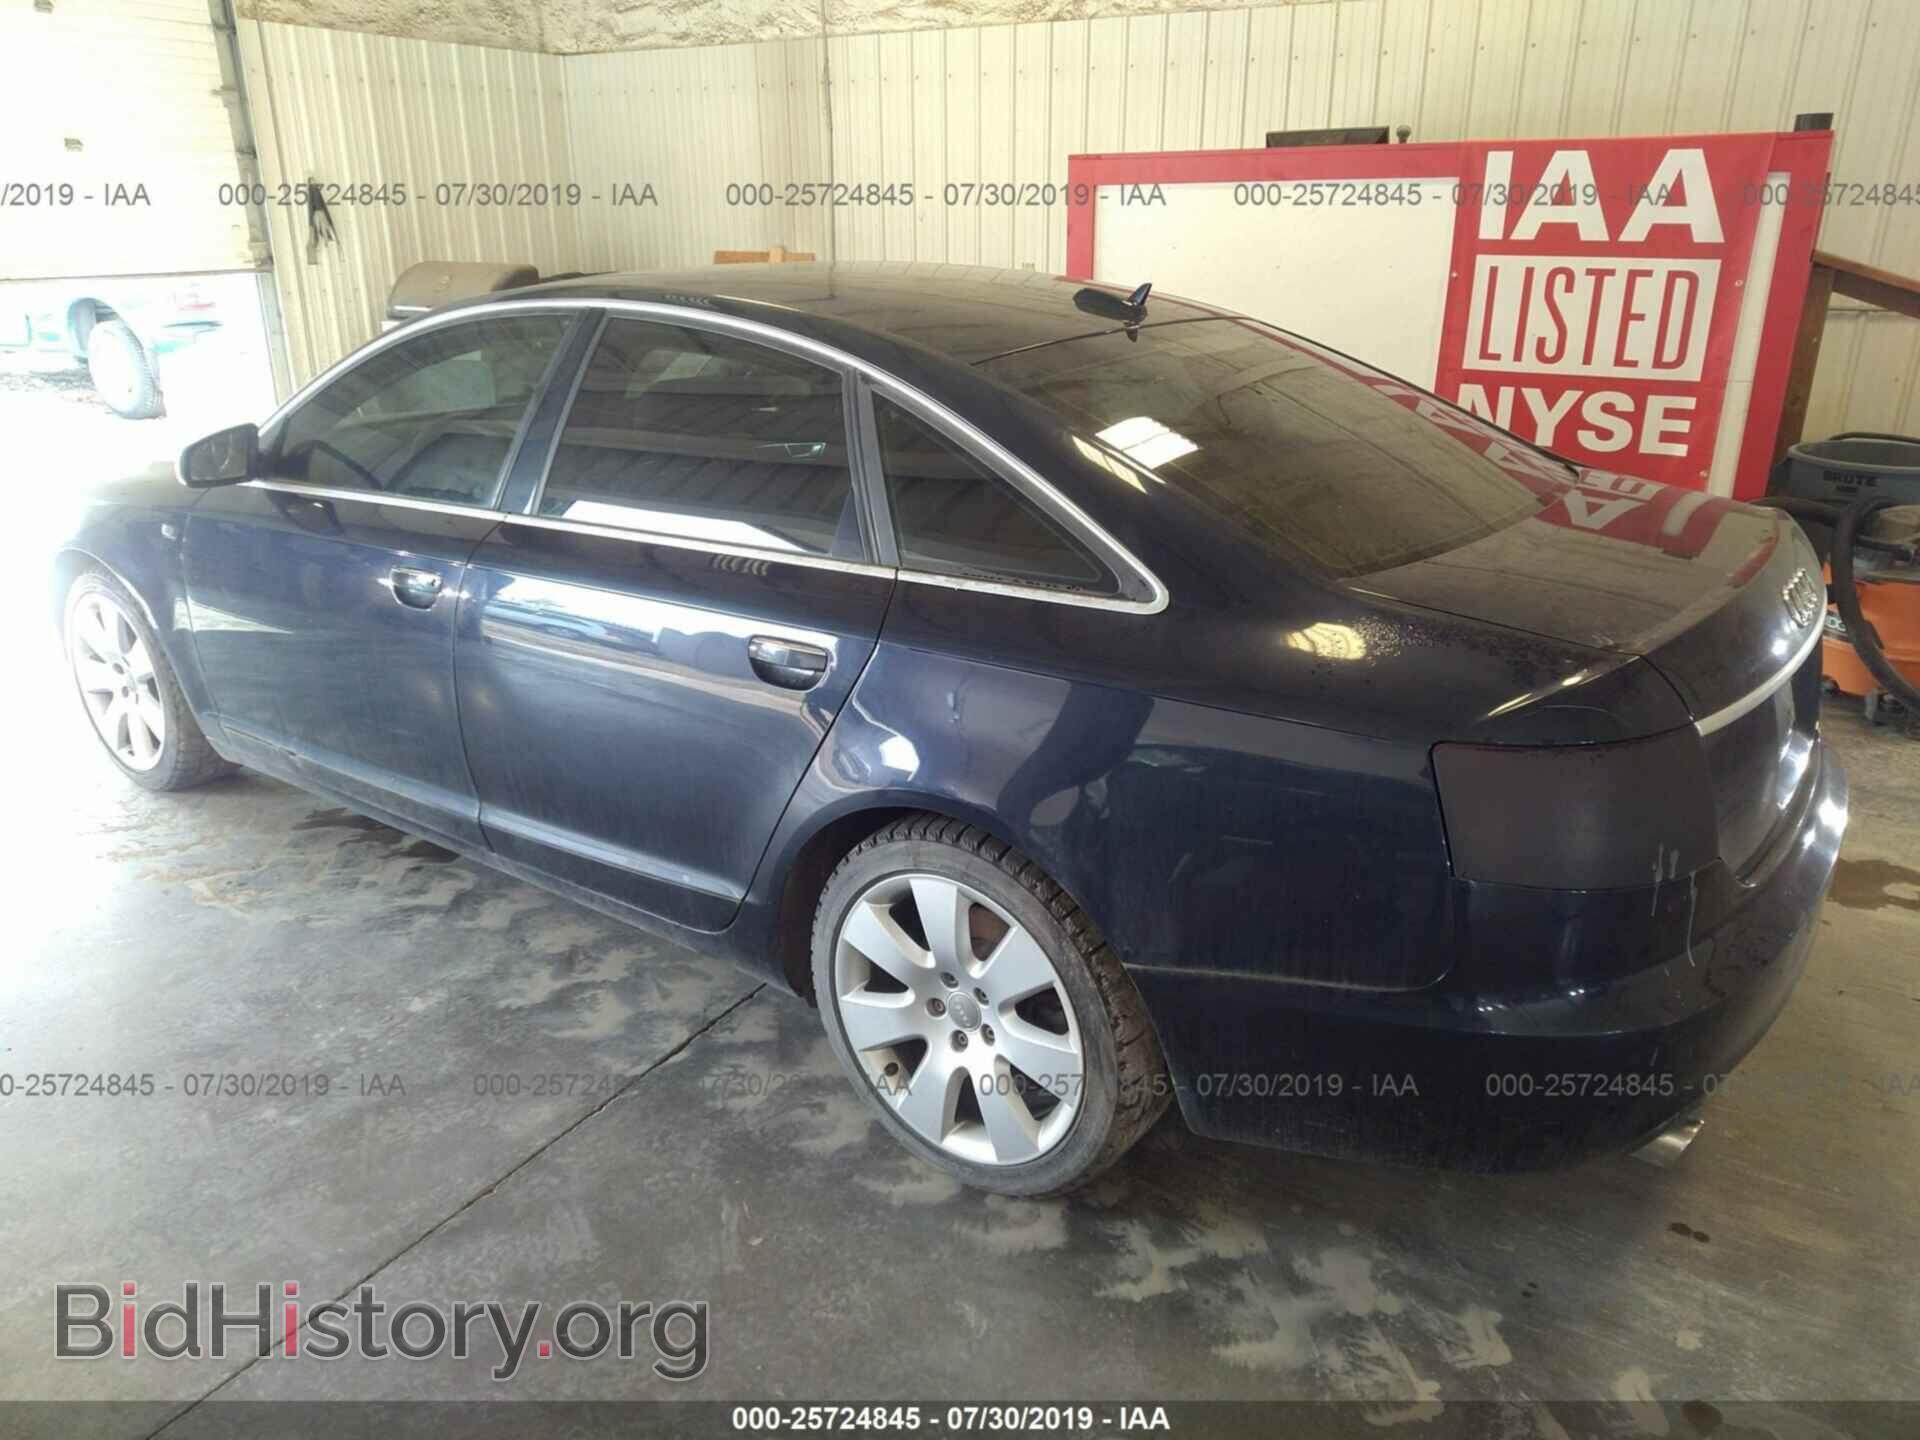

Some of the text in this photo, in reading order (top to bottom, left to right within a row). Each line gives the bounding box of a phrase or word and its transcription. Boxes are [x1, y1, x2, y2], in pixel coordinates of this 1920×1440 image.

[1478, 148, 1725, 243] IAA
[1478, 265, 1700, 371] LISTED
[1456, 384, 1697, 457] NYSE
